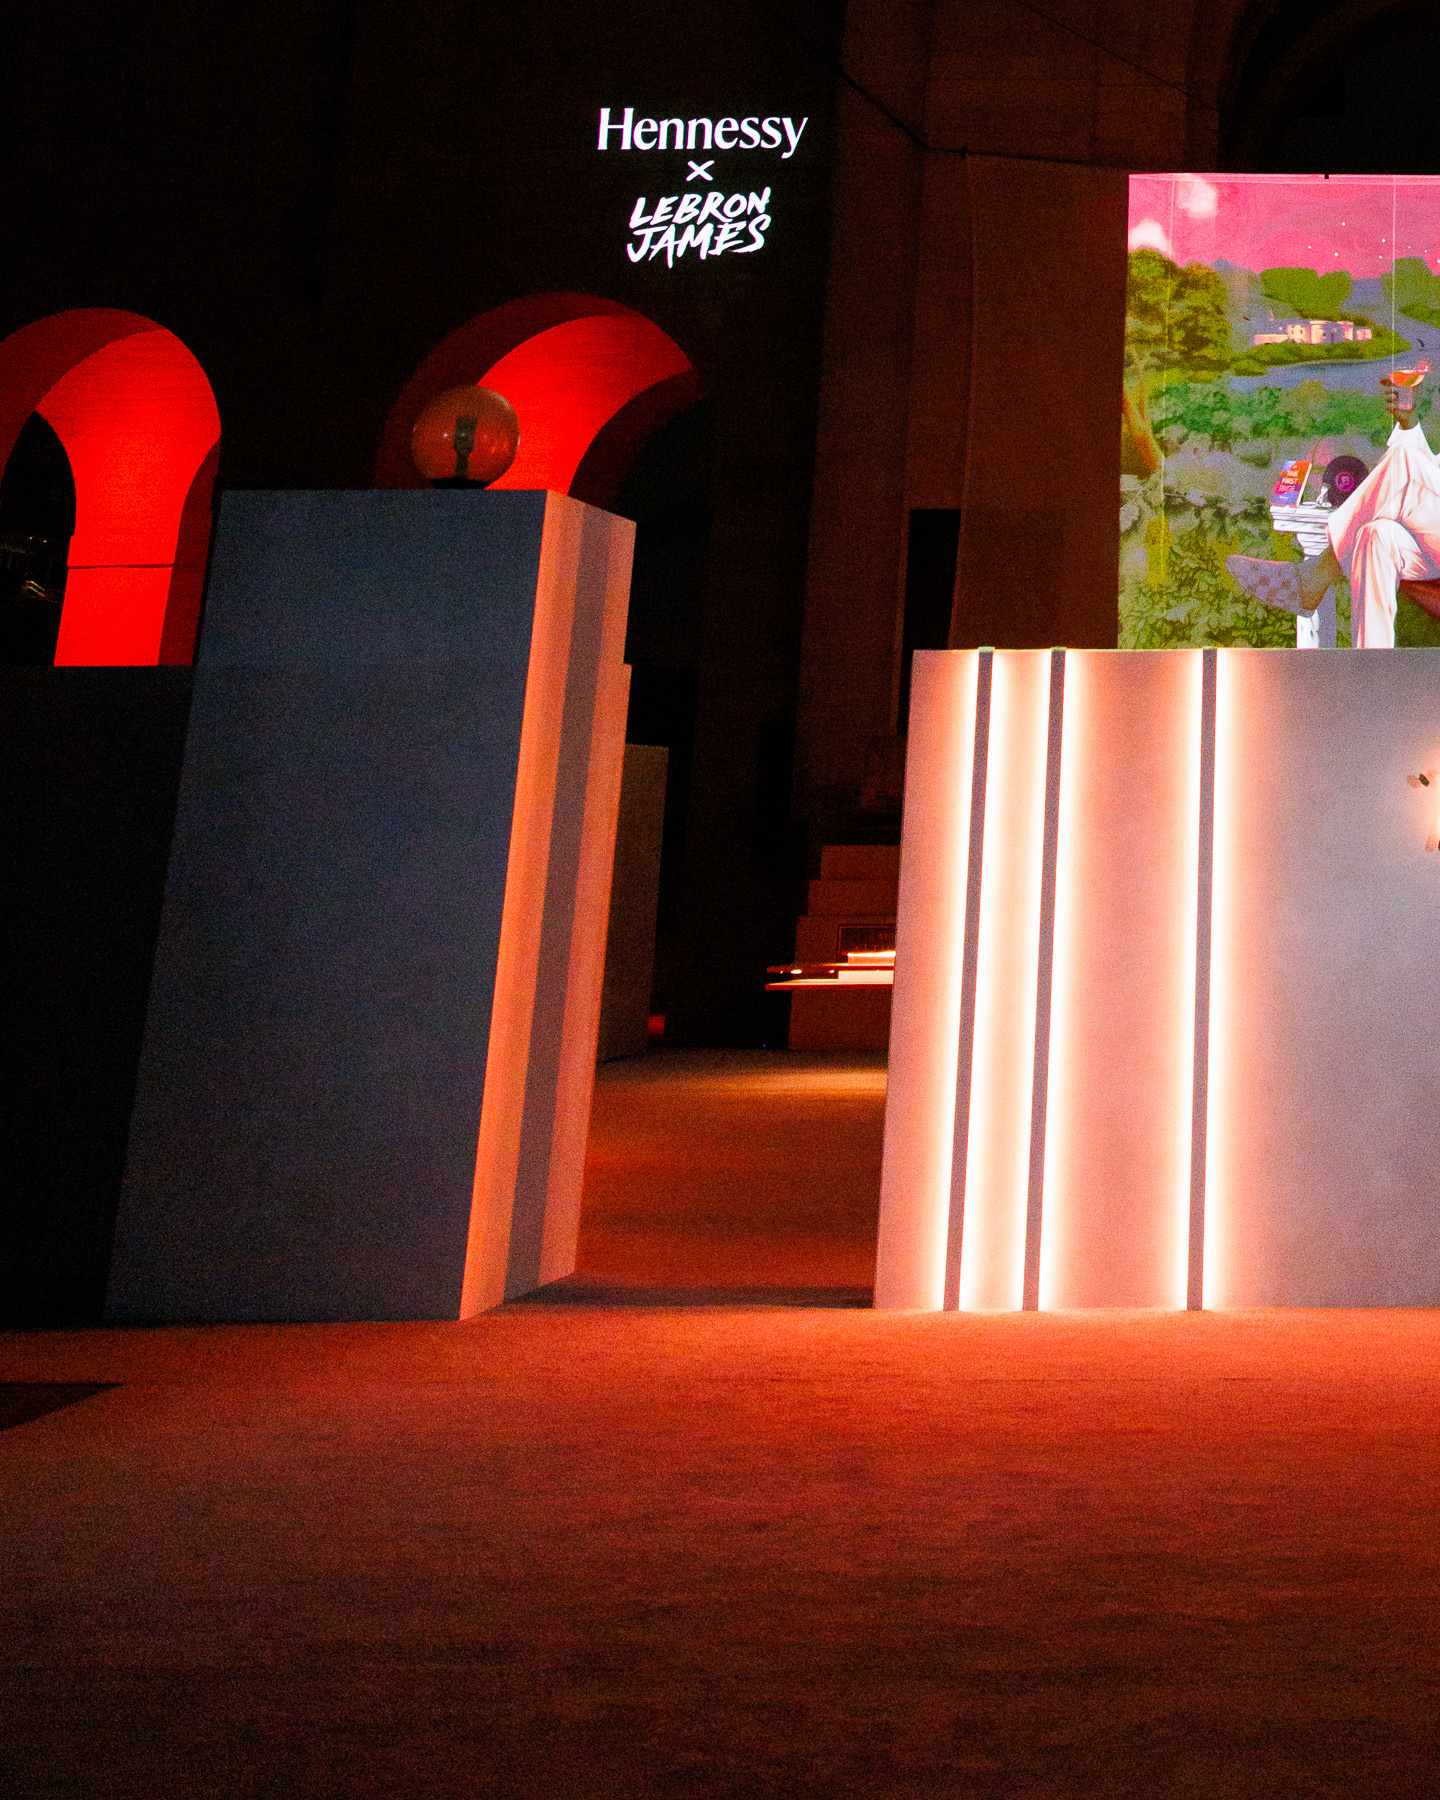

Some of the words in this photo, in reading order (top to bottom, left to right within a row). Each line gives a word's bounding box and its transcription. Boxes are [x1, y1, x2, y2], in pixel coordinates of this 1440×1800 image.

[597, 107, 809, 159] Hennessy
[628, 187, 772, 229] LEBRON
[626, 214, 772, 269] JAMES
